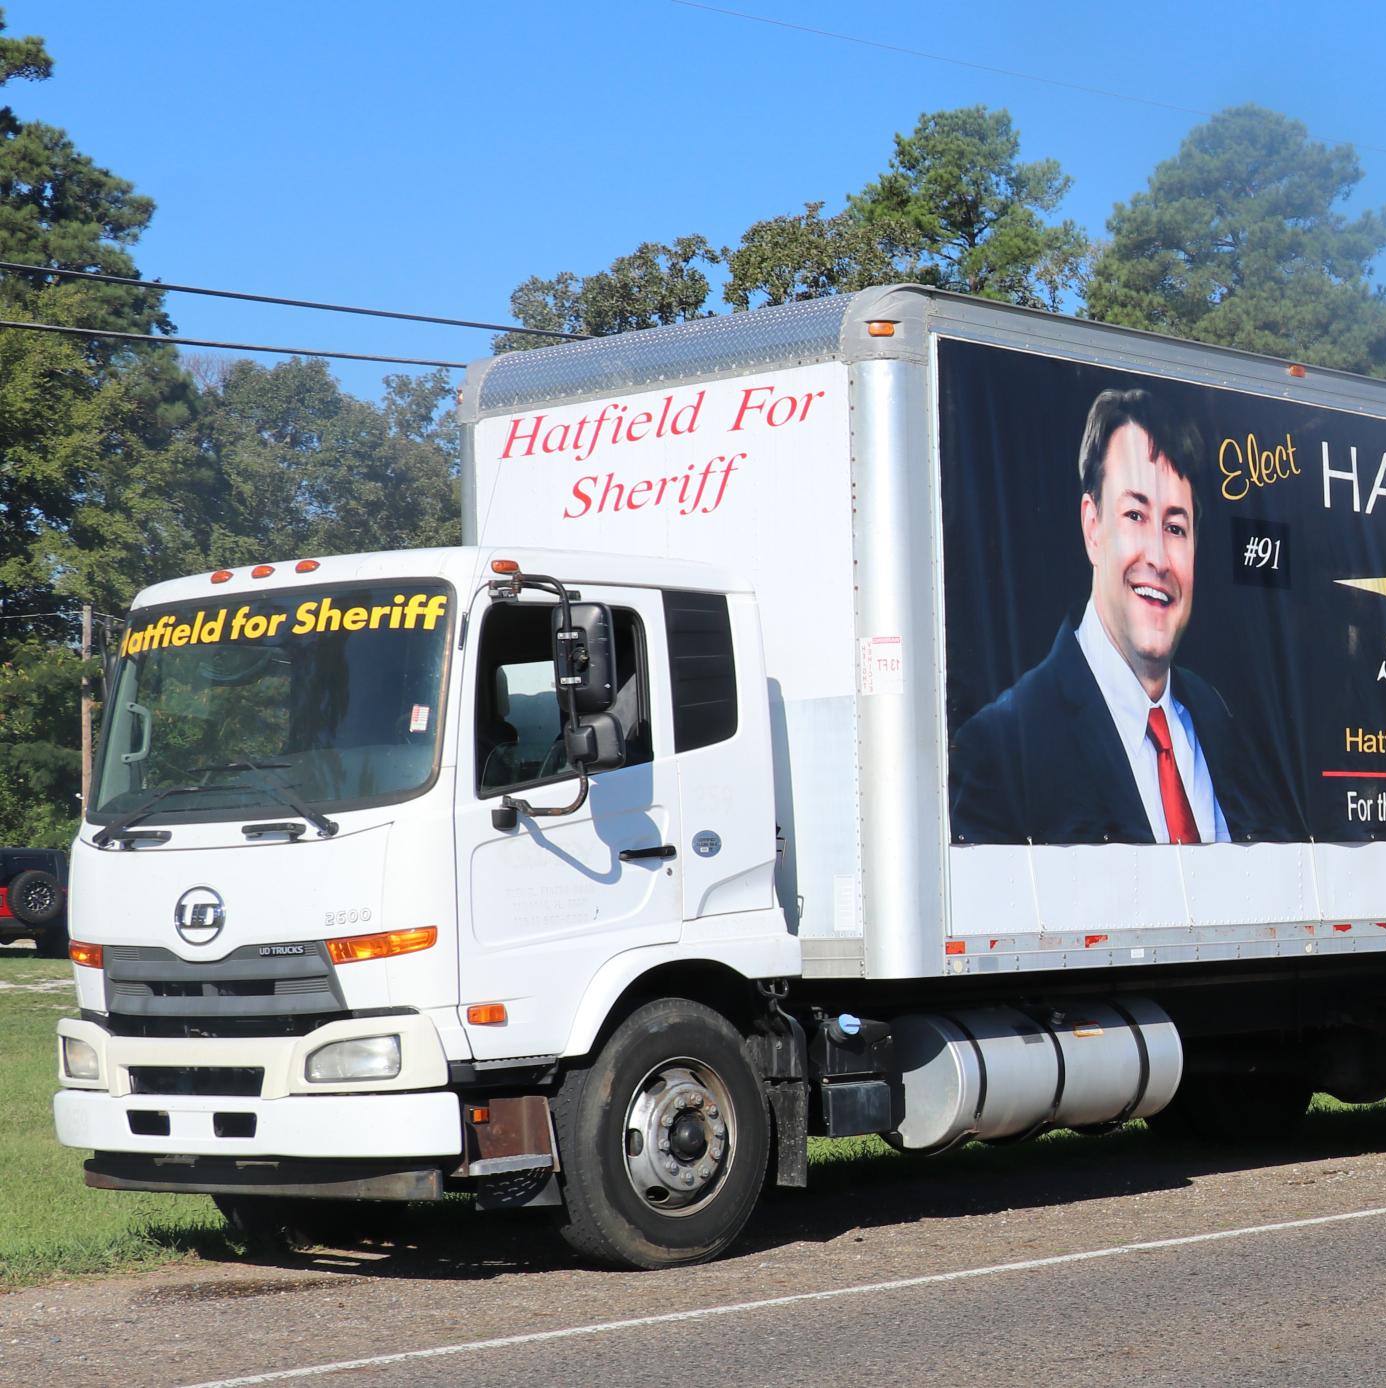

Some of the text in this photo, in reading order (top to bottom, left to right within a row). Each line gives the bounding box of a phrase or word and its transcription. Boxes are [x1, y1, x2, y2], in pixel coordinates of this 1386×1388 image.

[497, 386, 825, 462] Hatfield For
[562, 452, 748, 520] Sheriff
[1219, 432, 1301, 500] Elect
[1244, 536, 1281, 570] #91
[230, 604, 287, 640] for
[291, 594, 448, 634] Sheriff
[1347, 791, 1371, 822] For
[259, 945, 304, 956] UD TRUCKS
